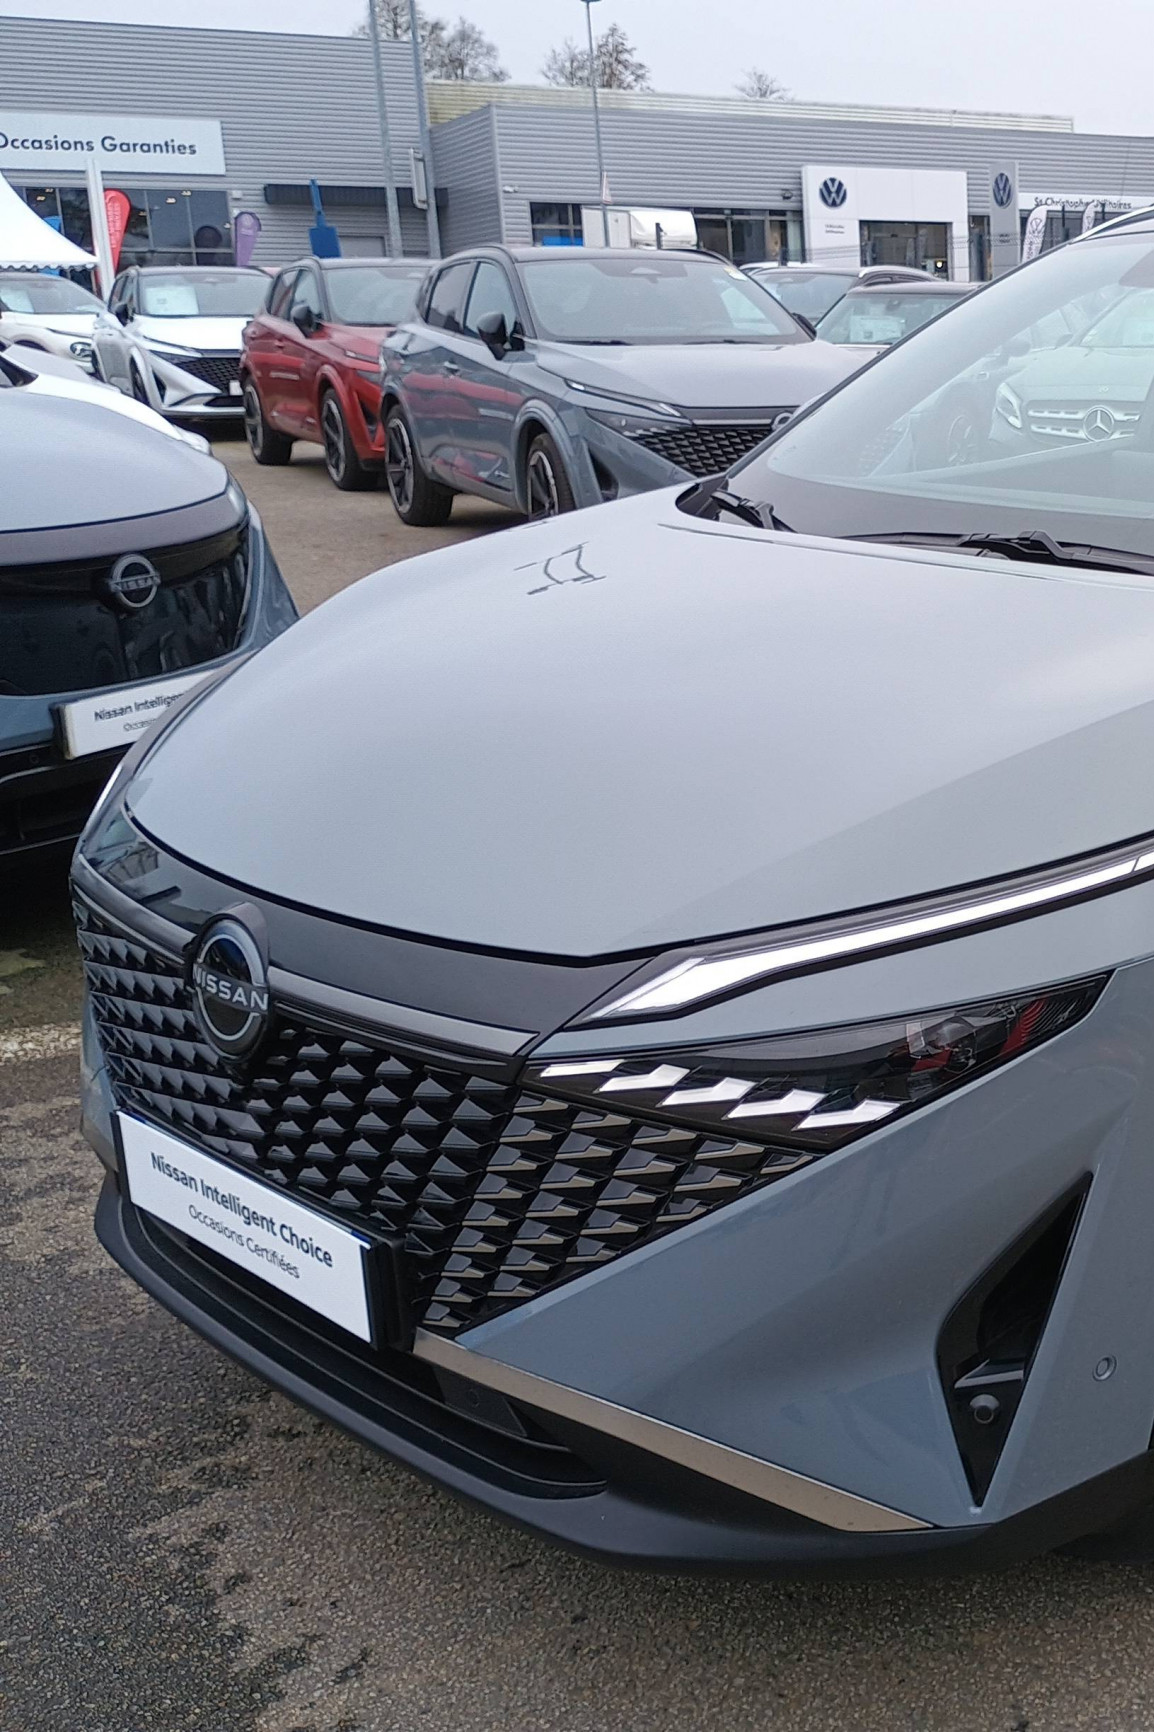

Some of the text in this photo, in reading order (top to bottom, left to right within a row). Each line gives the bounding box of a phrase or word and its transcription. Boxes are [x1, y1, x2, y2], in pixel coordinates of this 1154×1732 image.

[101, 135, 197, 155] Garanties
[94, 693, 184, 721] Nissan Intellige
[193, 963, 269, 1011] NISSAN
[150, 1152, 334, 1268] Nissan Intelligent Choice
[188, 1204, 301, 1279] Occasions Certifiées
